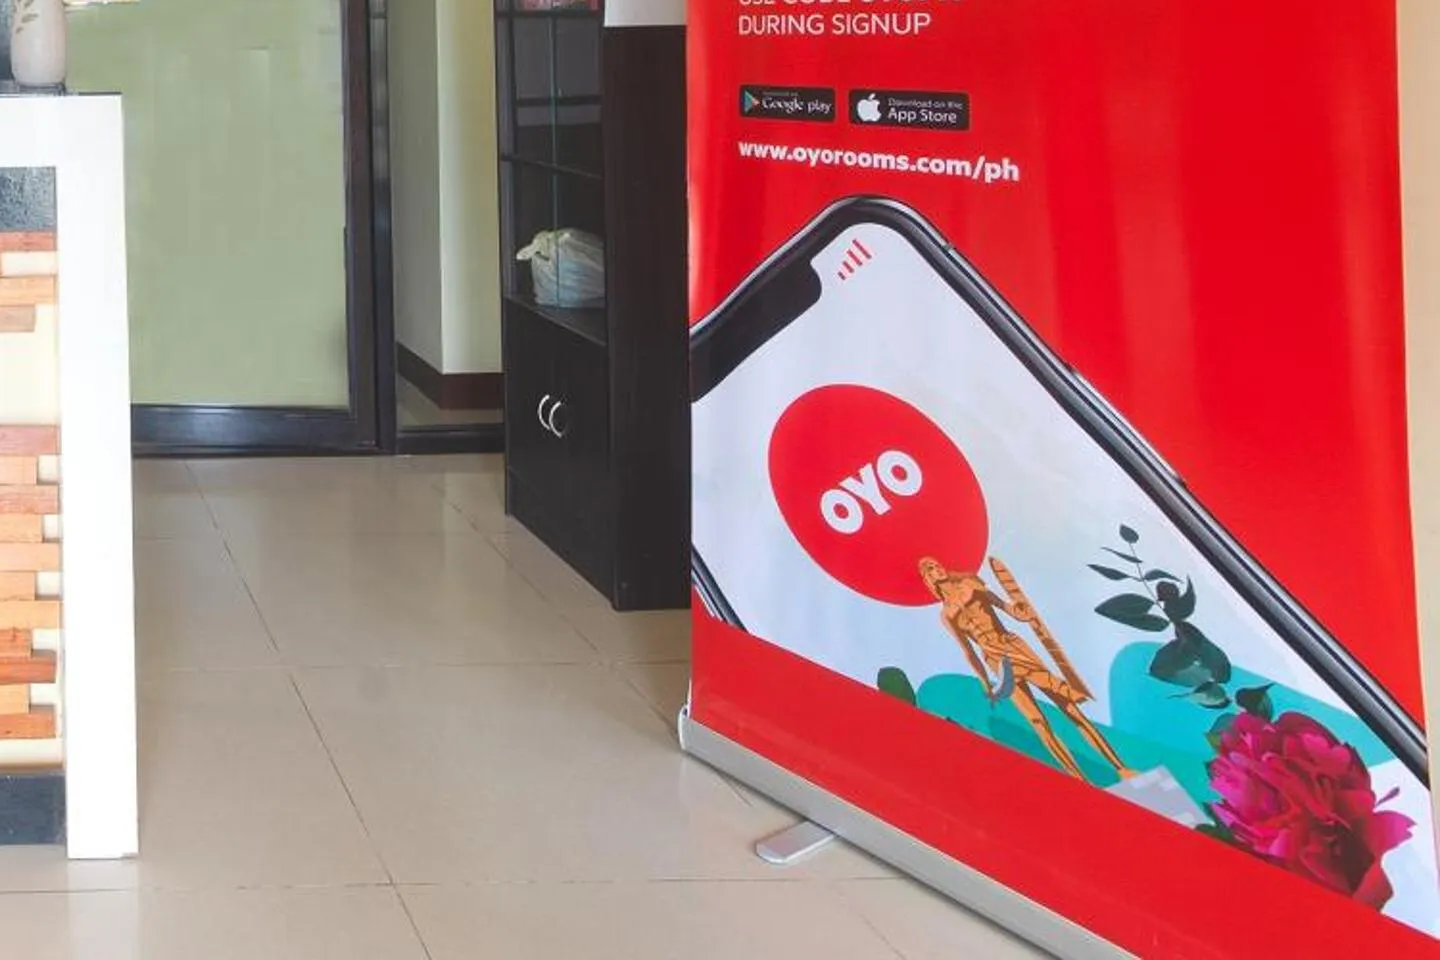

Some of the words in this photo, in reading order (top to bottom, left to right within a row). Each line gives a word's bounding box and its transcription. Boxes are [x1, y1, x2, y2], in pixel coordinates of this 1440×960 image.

[738, 14, 825, 35] DURING
[832, 13, 931, 35] SIGNUP
[762, 96, 803, 113] Google
[808, 99, 832, 114] play
[888, 98, 933, 108] Download
[887, 107, 916, 122] App
[920, 109, 957, 124] Store
[738, 142, 1020, 183] www.oyorooms.com/ph
[819, 449, 923, 535] OYO
